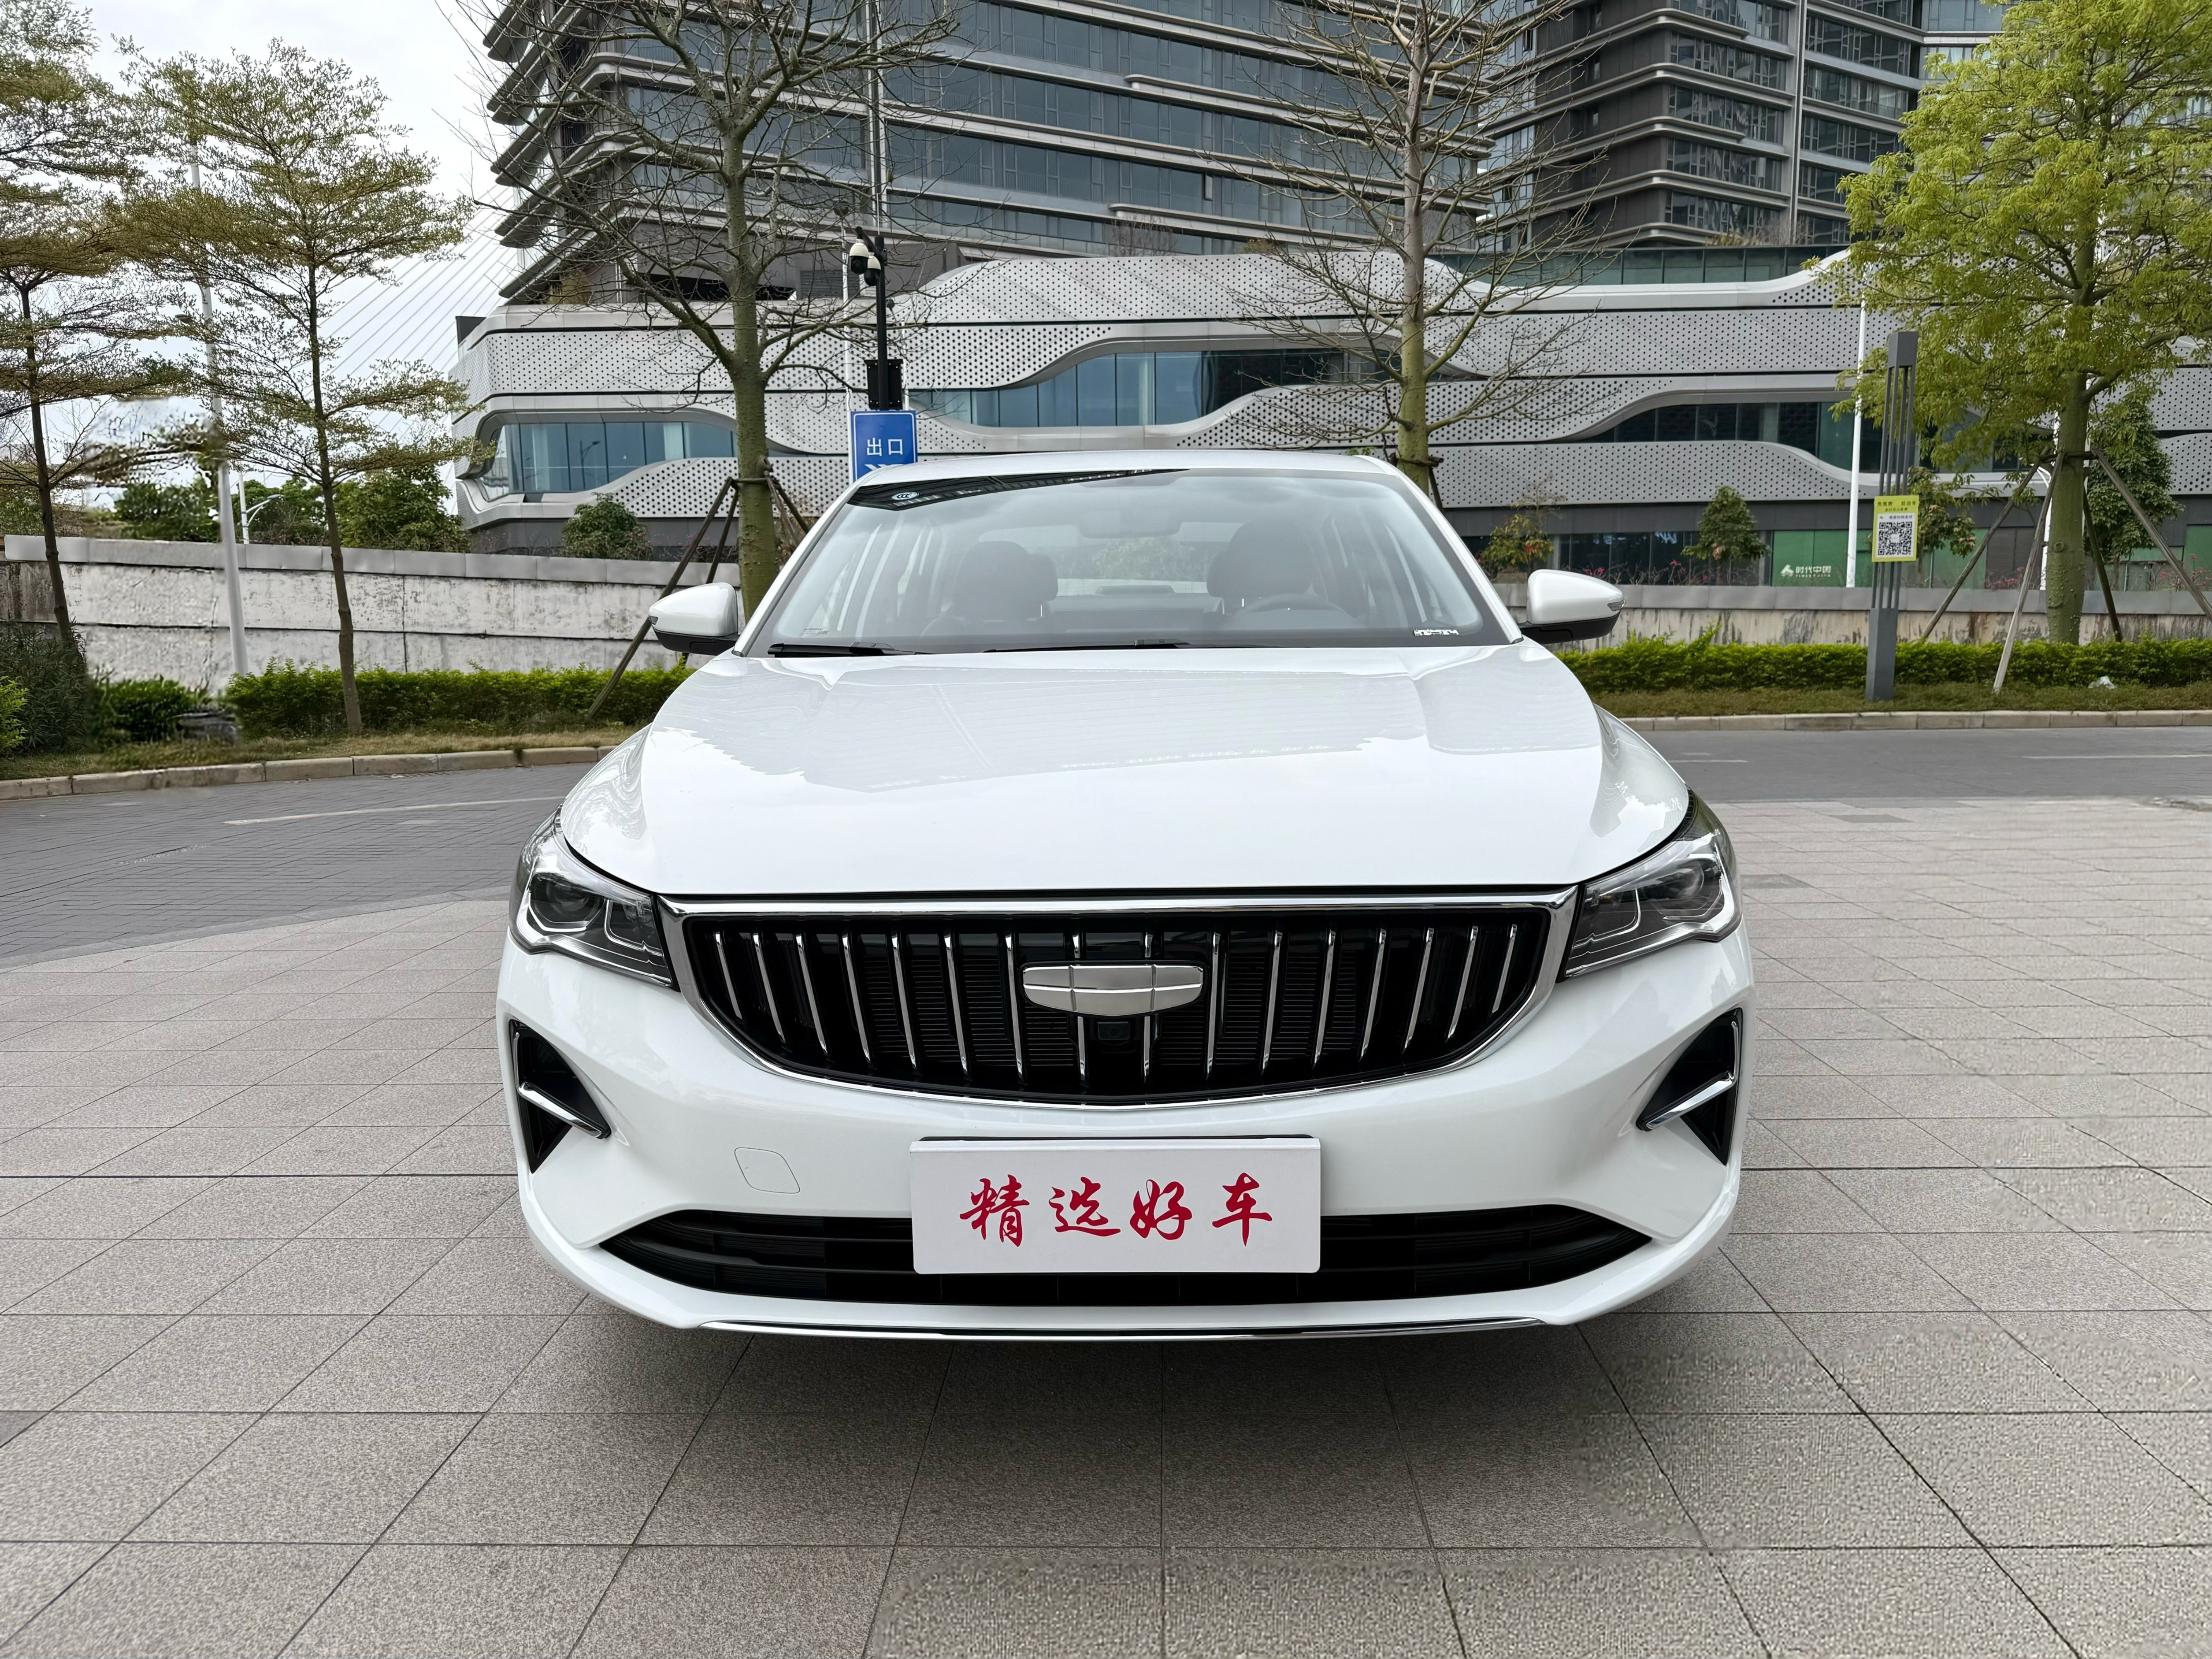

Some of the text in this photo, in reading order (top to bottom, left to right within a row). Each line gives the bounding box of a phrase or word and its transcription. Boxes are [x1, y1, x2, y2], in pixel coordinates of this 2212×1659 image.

[867, 438, 903, 456] 出口
[959, 1172, 1273, 1247] 精选好车
